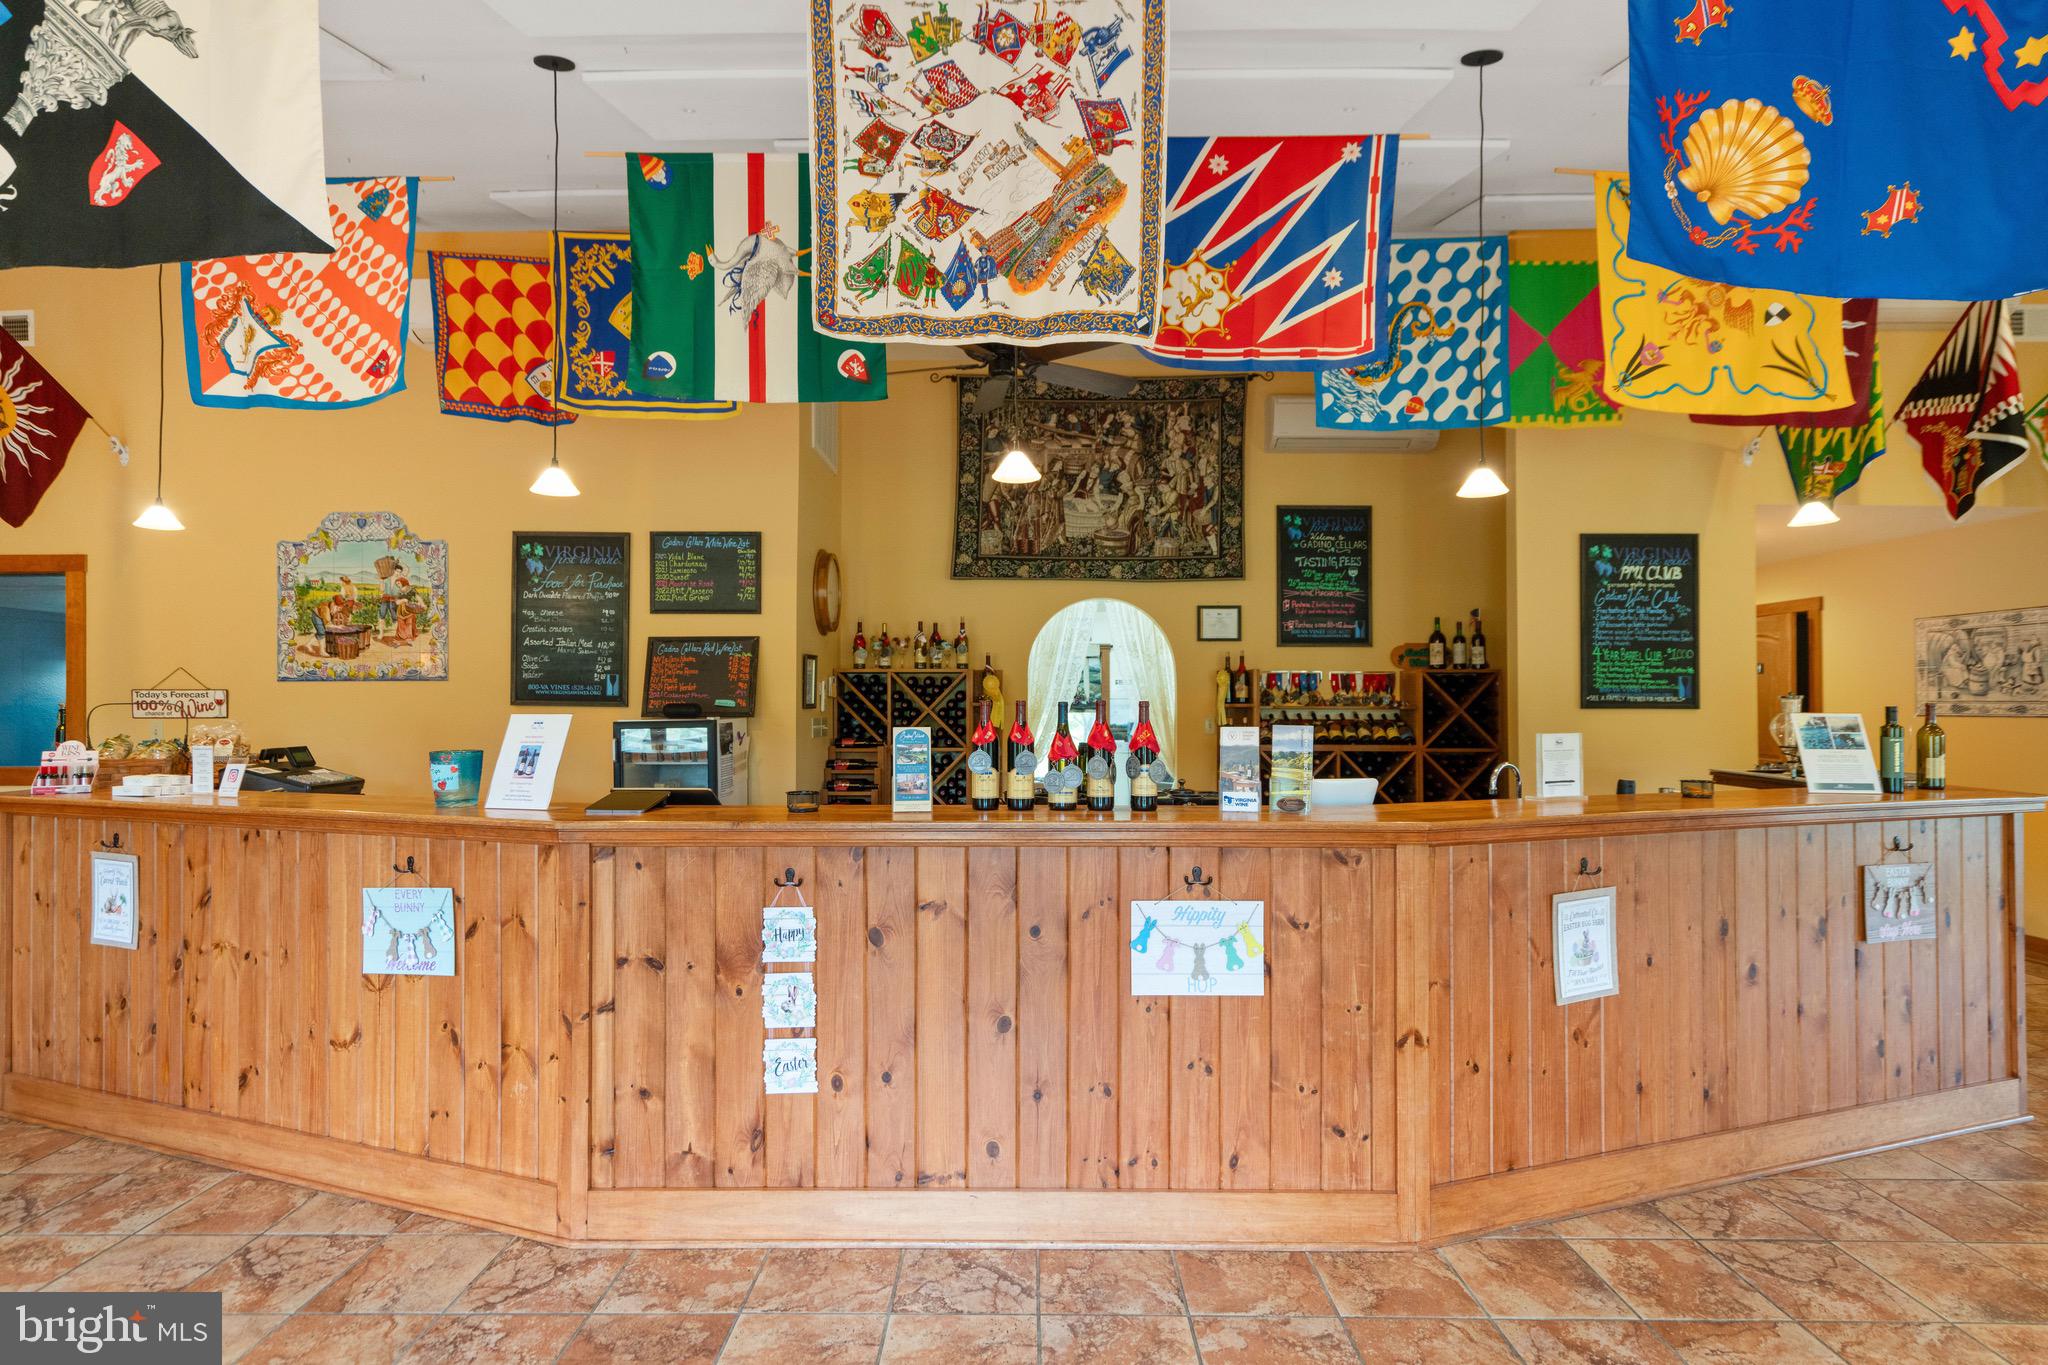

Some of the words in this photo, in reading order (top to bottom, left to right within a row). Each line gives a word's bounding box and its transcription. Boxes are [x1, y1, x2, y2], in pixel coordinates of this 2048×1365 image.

[545, 545, 622, 558] VIRGINIA
[1300, 540, 1332, 549] GADINO
[1335, 540, 1368, 550] CELLARS
[687, 552, 705, 560] Blanc
[1613, 546, 1692, 559] VIRGINIA
[668, 559, 707, 571] Chardonnay
[1295, 556, 1339, 569] TASTING
[1340, 556, 1362, 567] FEES
[1645, 565, 1683, 581] CLUB
[523, 637, 554, 646] Assorted
[555, 637, 577, 647] Italian
[521, 661, 539, 669] Soda
[521, 670, 544, 679] Water
[135, 691, 167, 699] Today's
[170, 691, 209, 699] Forecast
[136, 700, 173, 711] 100%
[174, 699, 215, 719] Wine
[394, 889, 423, 900] EVERY
[394, 903, 425, 912] BUNNY
[1172, 905, 1226, 929] Hippity
[1563, 922, 1581, 932] EASTER
[1581, 919, 1592, 928] EGG
[774, 927, 805, 943] Happy
[1187, 976, 1218, 993] HOP
[775, 1057, 809, 1077] Easter
